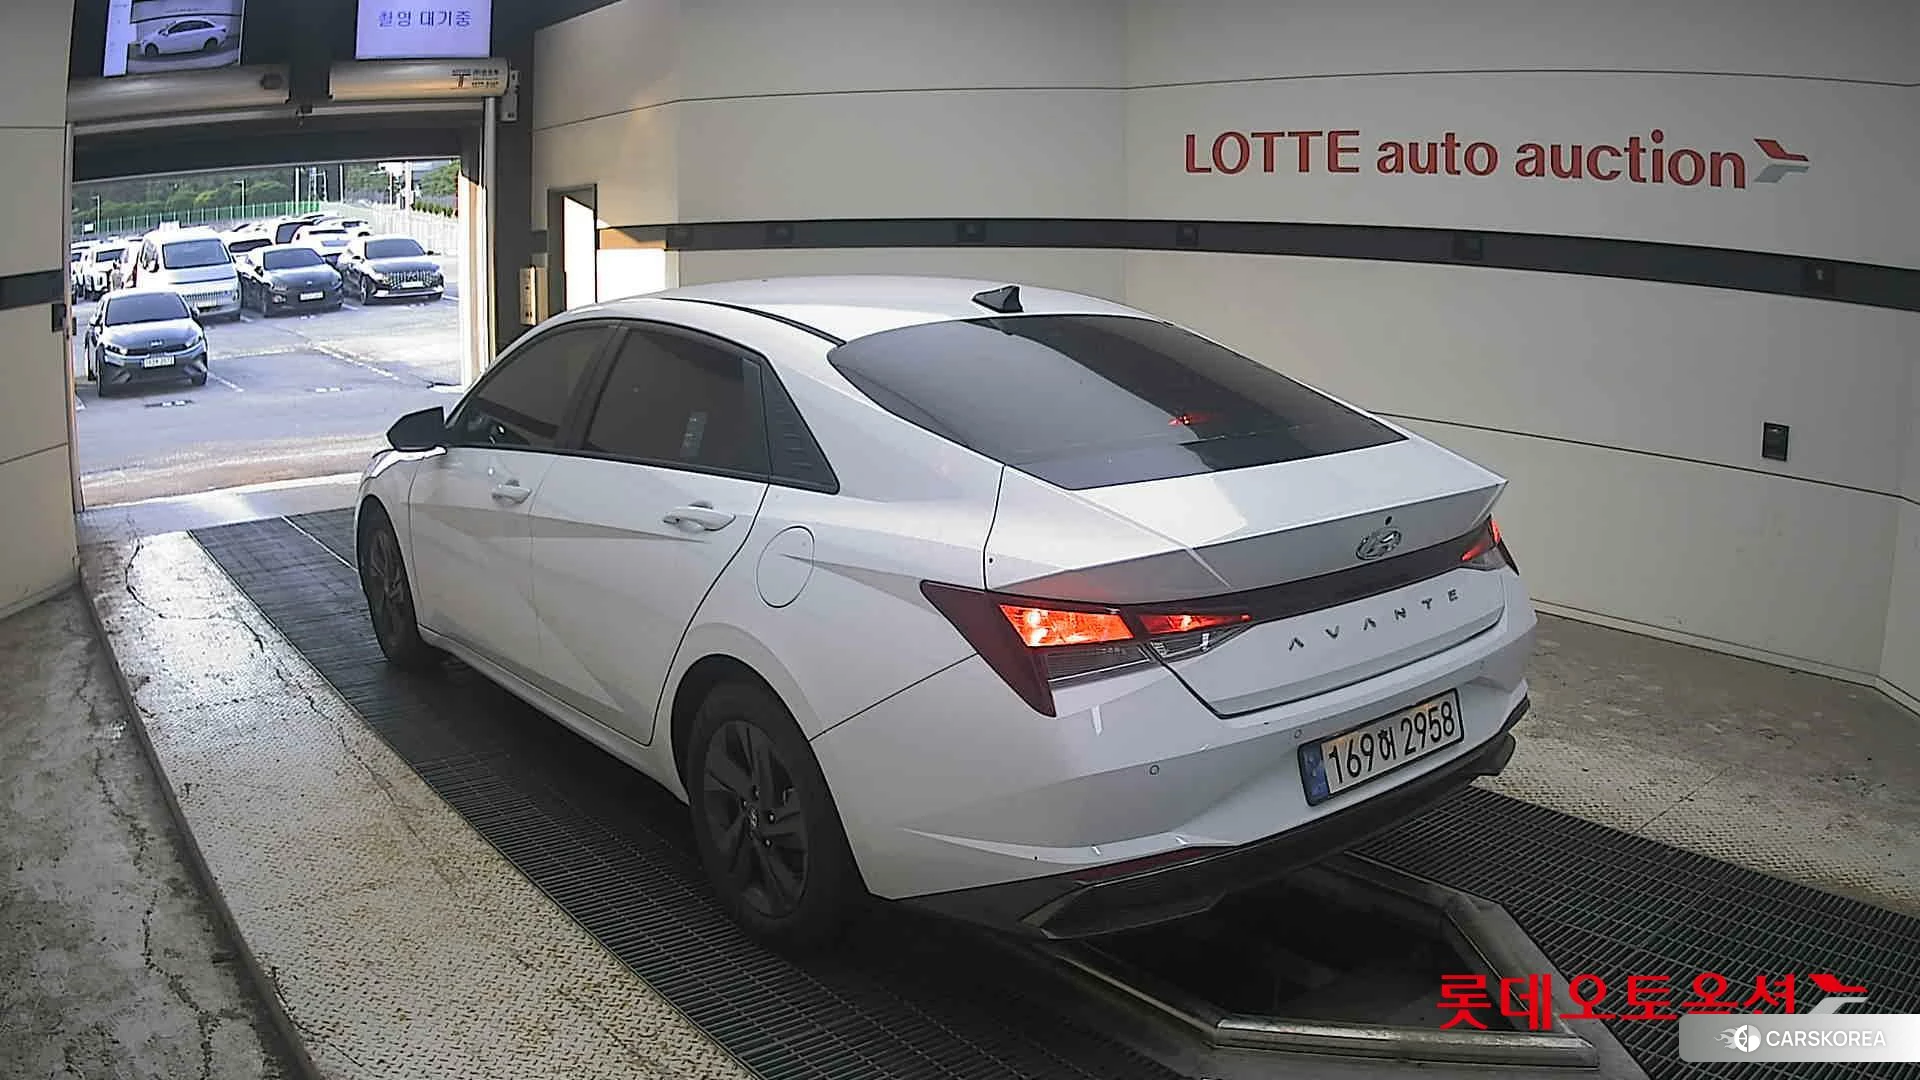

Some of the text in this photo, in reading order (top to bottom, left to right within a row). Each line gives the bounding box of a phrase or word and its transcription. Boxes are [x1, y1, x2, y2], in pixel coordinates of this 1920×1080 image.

[420, 10, 472, 27] 대기중
[1184, 129, 1746, 189] LOTTE auto auction
[1289, 588, 1459, 651] AVANTE
